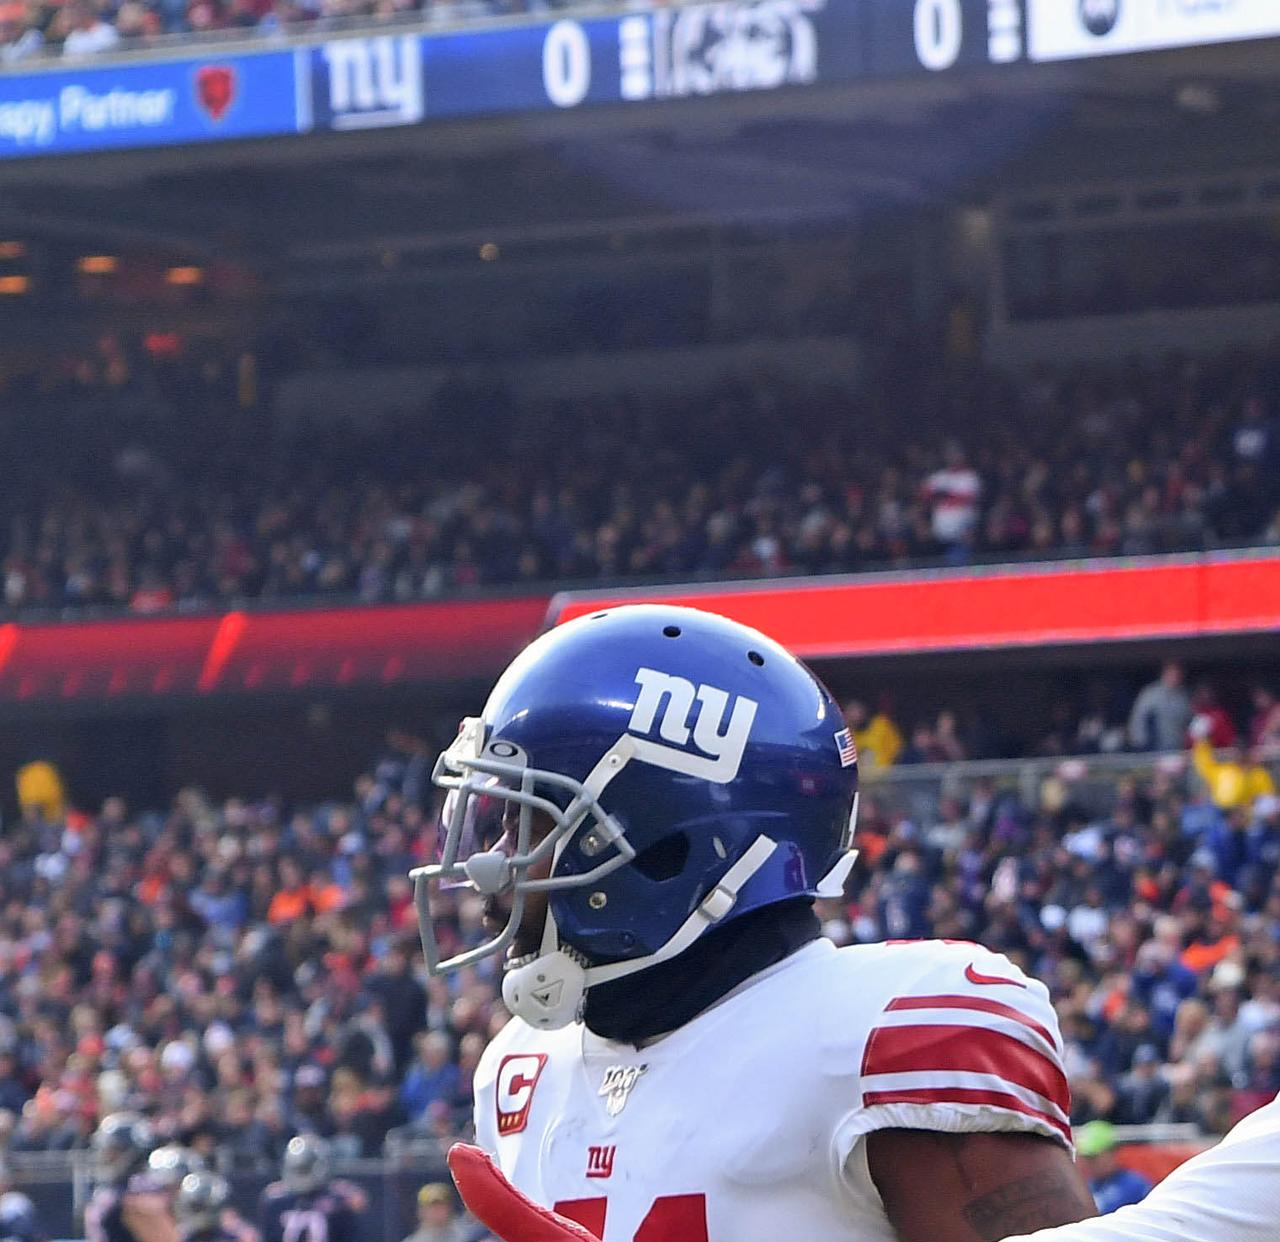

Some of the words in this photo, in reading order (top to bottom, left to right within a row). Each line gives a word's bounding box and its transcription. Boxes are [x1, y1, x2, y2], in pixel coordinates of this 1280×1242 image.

[542, 19, 591, 108] 0
[627, 666, 759, 785] ny
[498, 1056, 541, 1114] C
